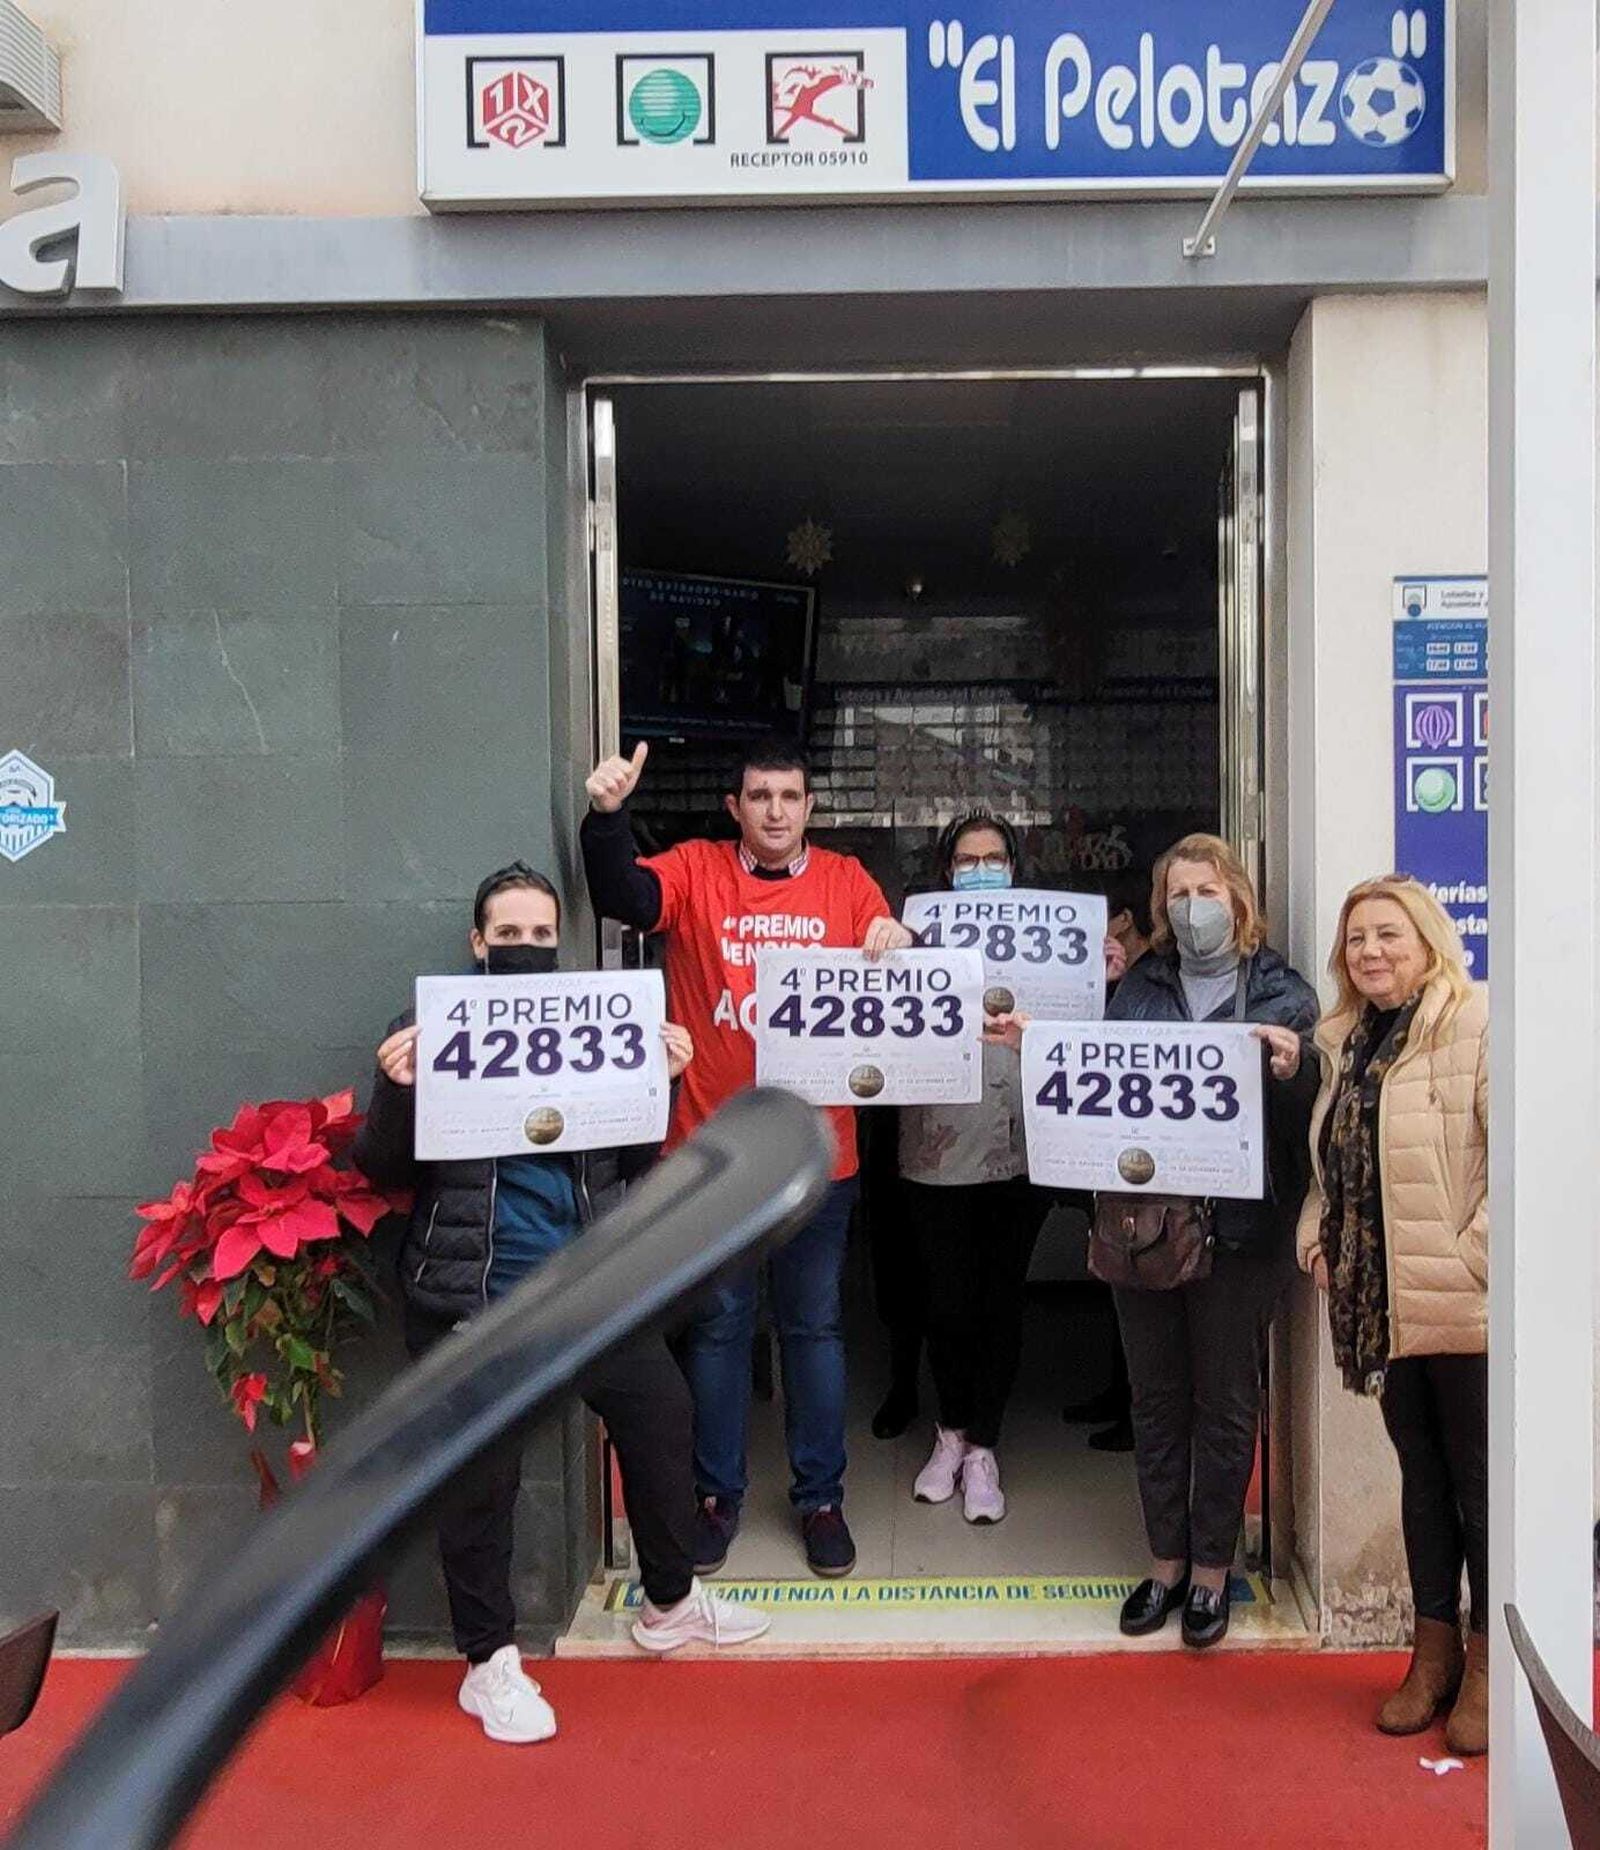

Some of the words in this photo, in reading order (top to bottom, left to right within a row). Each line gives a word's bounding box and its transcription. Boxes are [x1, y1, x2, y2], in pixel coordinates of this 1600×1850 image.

[730, 152, 814, 168] RECEPTOR
[818, 151, 868, 166] 05910
[739, 913, 827, 941] PREMIO
[955, 902, 1077, 924] PREMIO
[918, 922, 1089, 966] 42833
[815, 967, 952, 993] PREMIO
[487, 993, 632, 1026] PREMIO
[768, 994, 964, 1039] 42833
[432, 1022, 647, 1080] 42833
[1081, 1042, 1224, 1071] PREMIO
[1035, 1070, 1240, 1122] 42833
[878, 1585, 999, 1601] DISTANCIA
